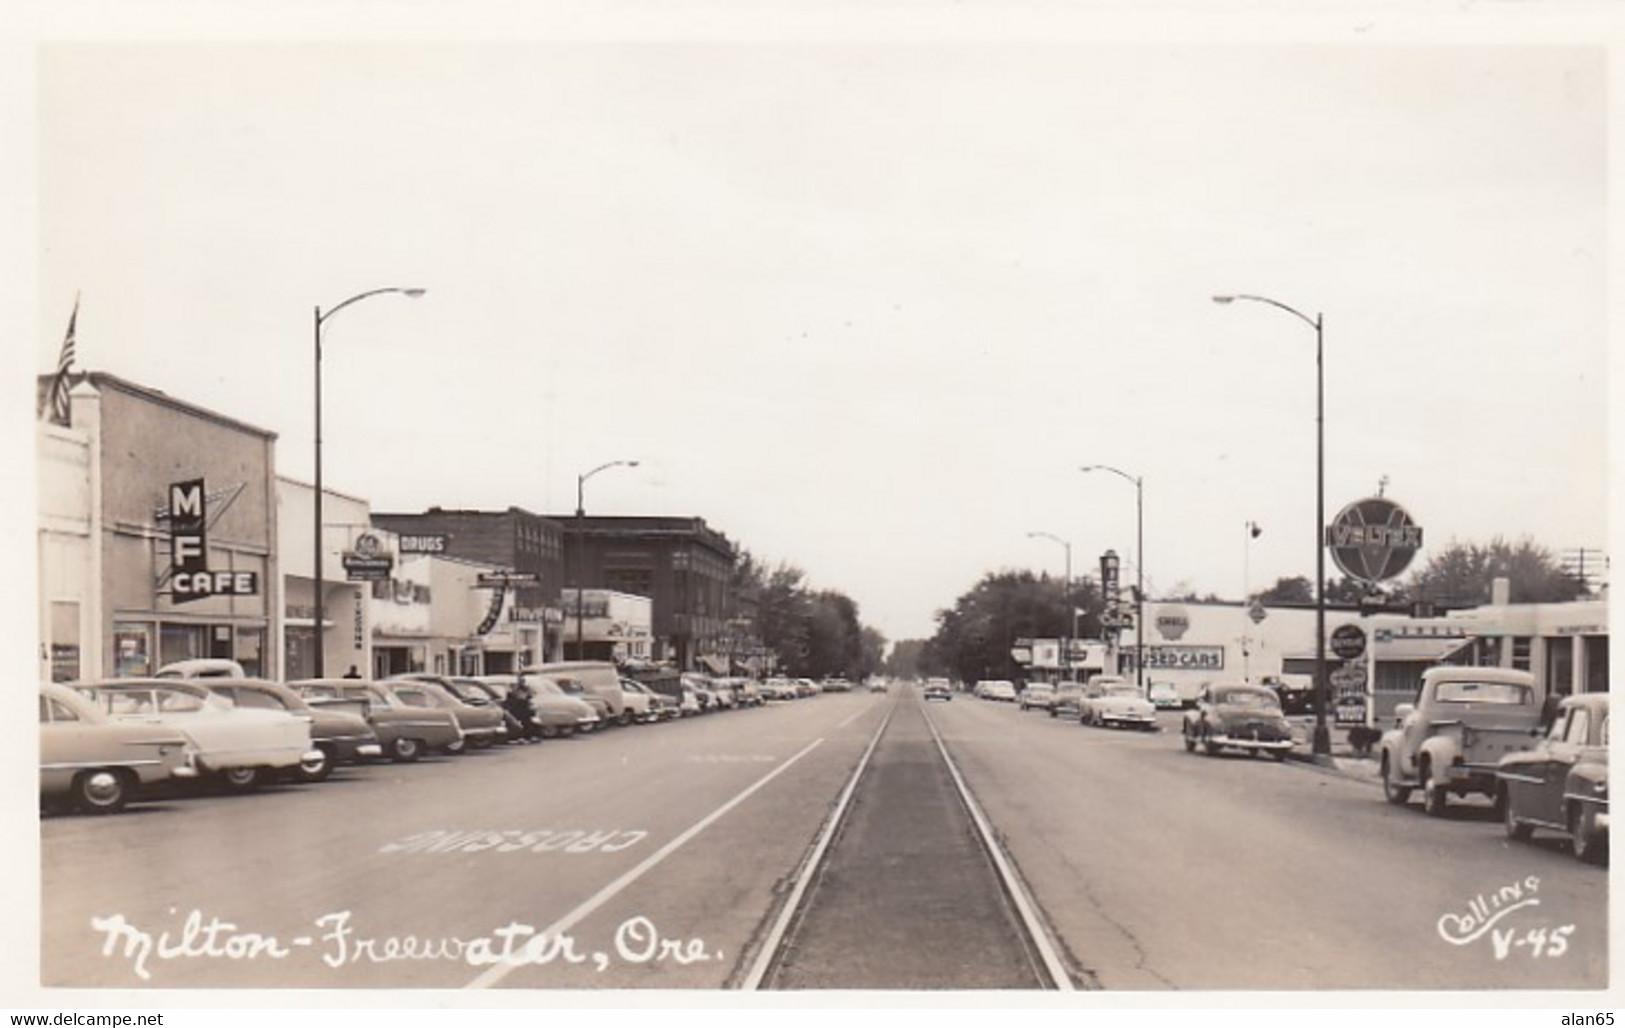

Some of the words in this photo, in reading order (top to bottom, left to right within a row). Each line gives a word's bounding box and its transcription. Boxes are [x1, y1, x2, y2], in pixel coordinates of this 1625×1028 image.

[172, 486, 201, 516] M
[401, 536, 444, 551] DRUGS
[1332, 525, 1418, 547] VELTEX
[175, 536, 201, 566] F
[173, 572, 252, 593] CAFE
[1180, 653, 1219, 664] CARS
